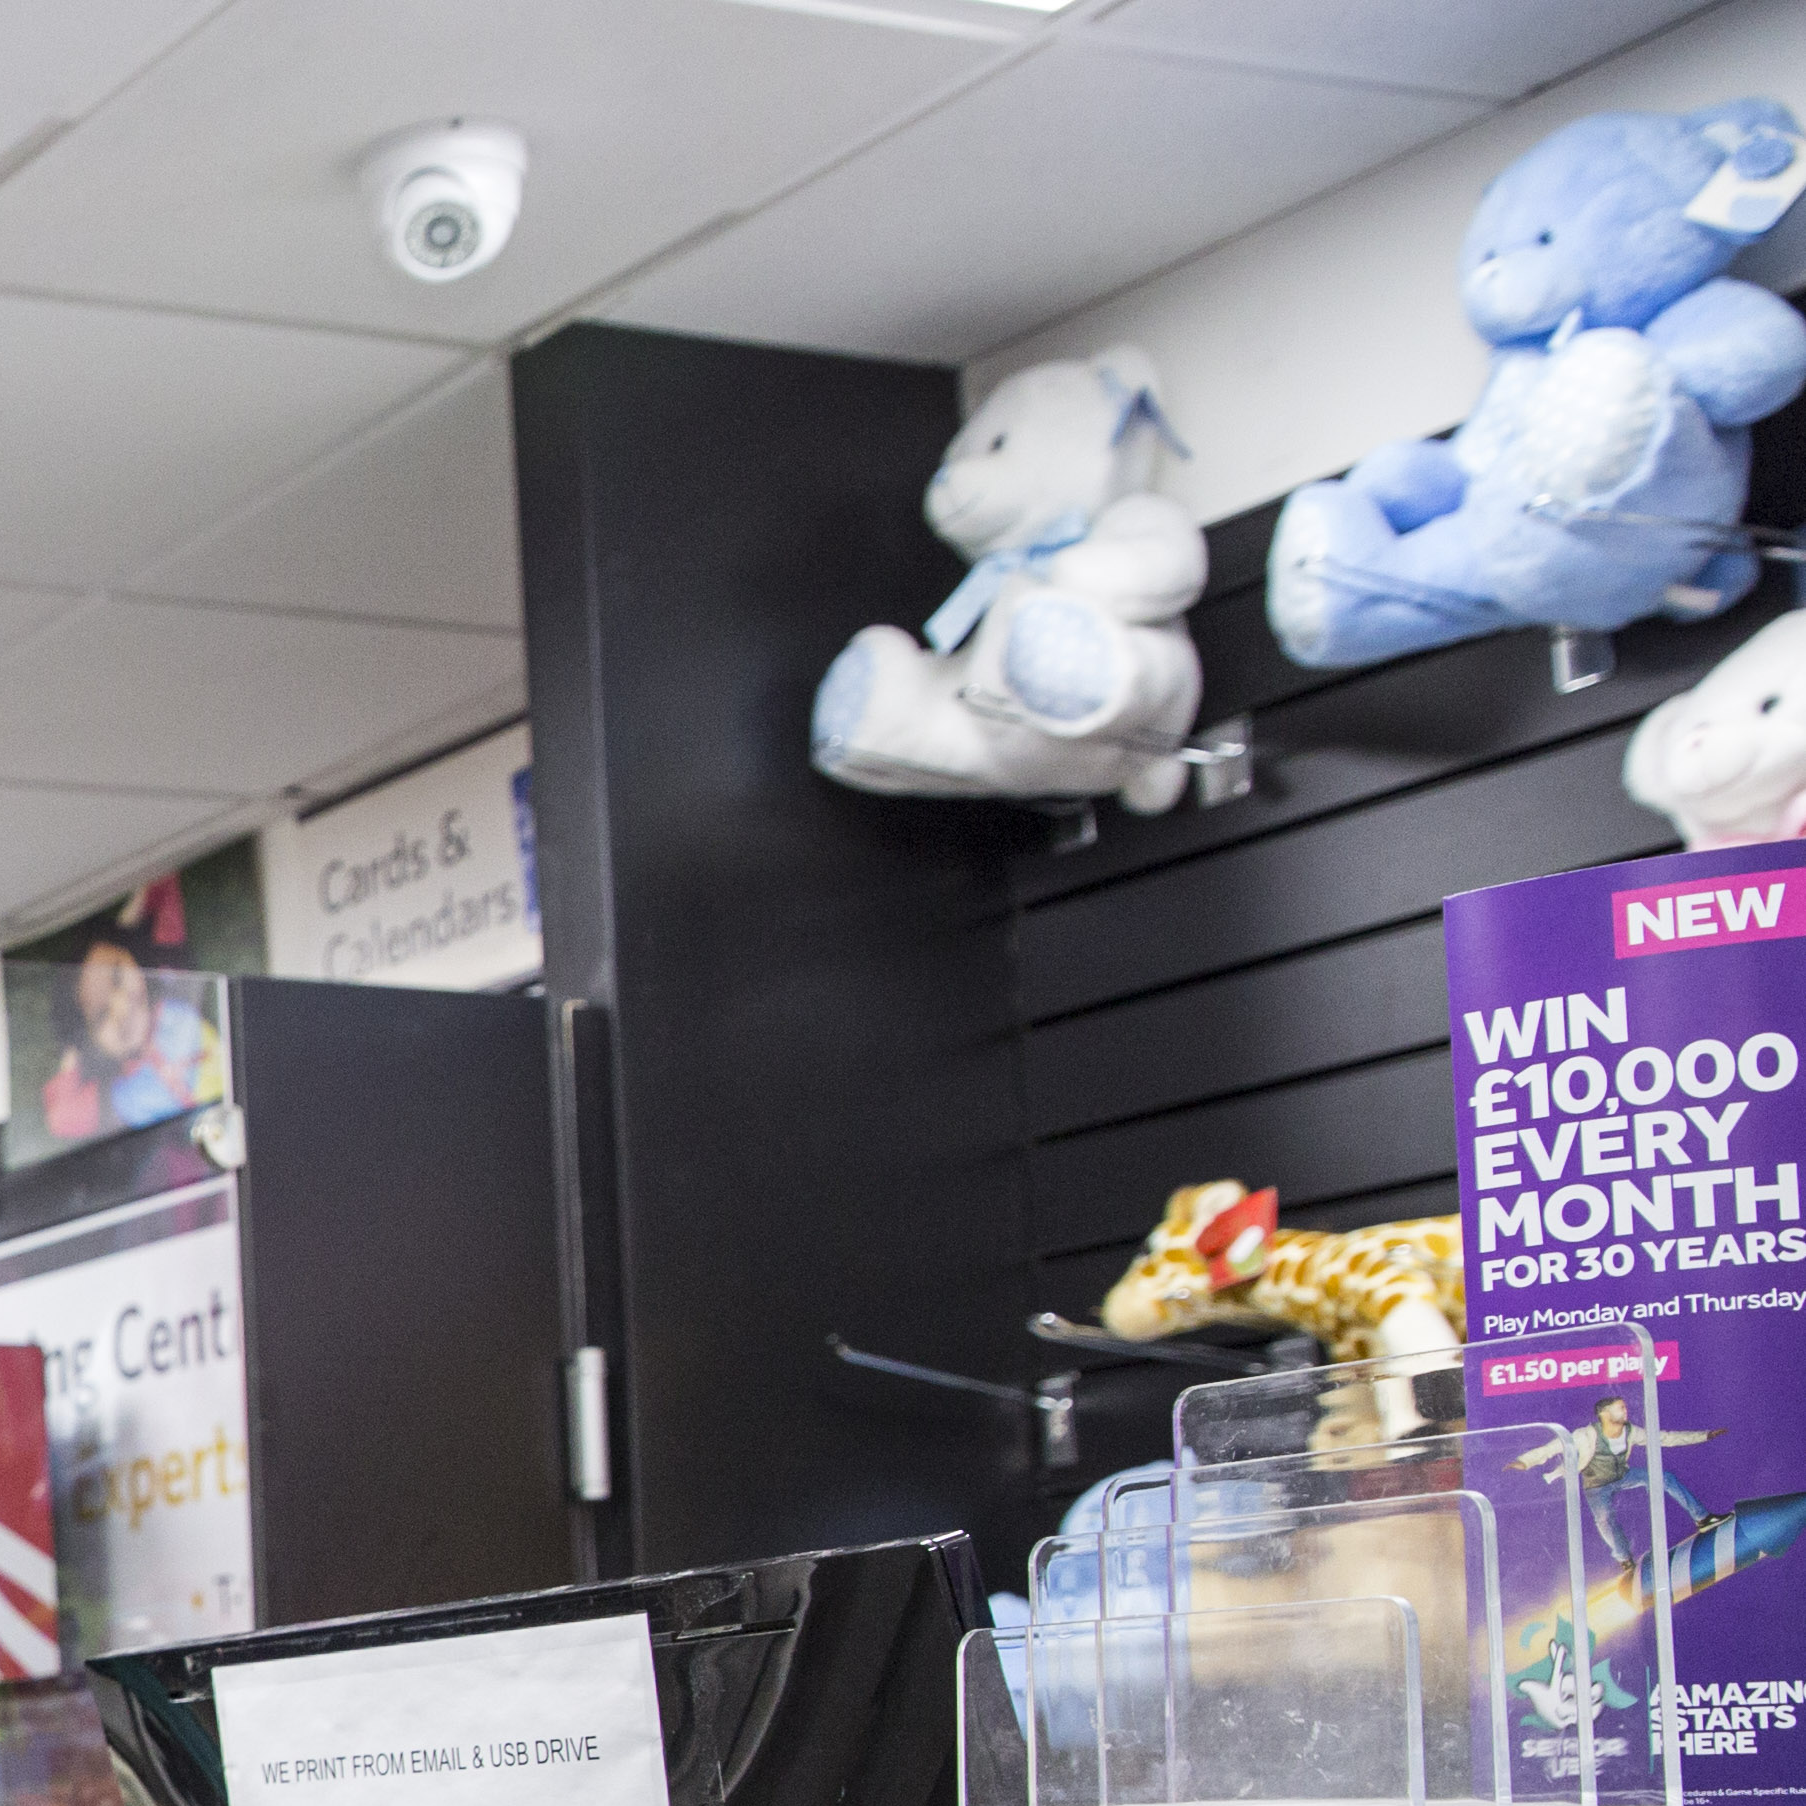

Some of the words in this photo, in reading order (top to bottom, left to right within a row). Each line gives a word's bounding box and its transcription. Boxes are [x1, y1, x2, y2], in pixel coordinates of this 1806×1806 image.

[316, 820, 430, 915] Cards
[436, 808, 474, 864] &
[1626, 883, 1786, 945] NEW
[1463, 987, 1629, 1065] WIN
[1468, 1031, 1799, 1128] £10,000
[1474, 1101, 1750, 1190] EVERY
[1477, 1163, 1801, 1253] MONTH
[1481, 1251, 1570, 1292] FOR
[1575, 1243, 1635, 1279] 30
[1641, 1228, 1806, 1273] YEARS
[1484, 1313, 1530, 1338] Play
[1533, 1303, 1630, 1332] Monday
[1633, 1295, 1680, 1320] and
[1490, 1358, 1557, 1386] £1.50
[1561, 1357, 1604, 1383] per
[1662, 1680, 1806, 1706] AMAZIN
[261, 1761, 291, 1785] WE
[295, 1756, 346, 1783] PRINT
[352, 1752, 406, 1778] FROM
[411, 1746, 467, 1774] EMAIL
[473, 1744, 485, 1770] &
[490, 1740, 530, 1767] USB
[534, 1735, 600, 1764] DRIVE
